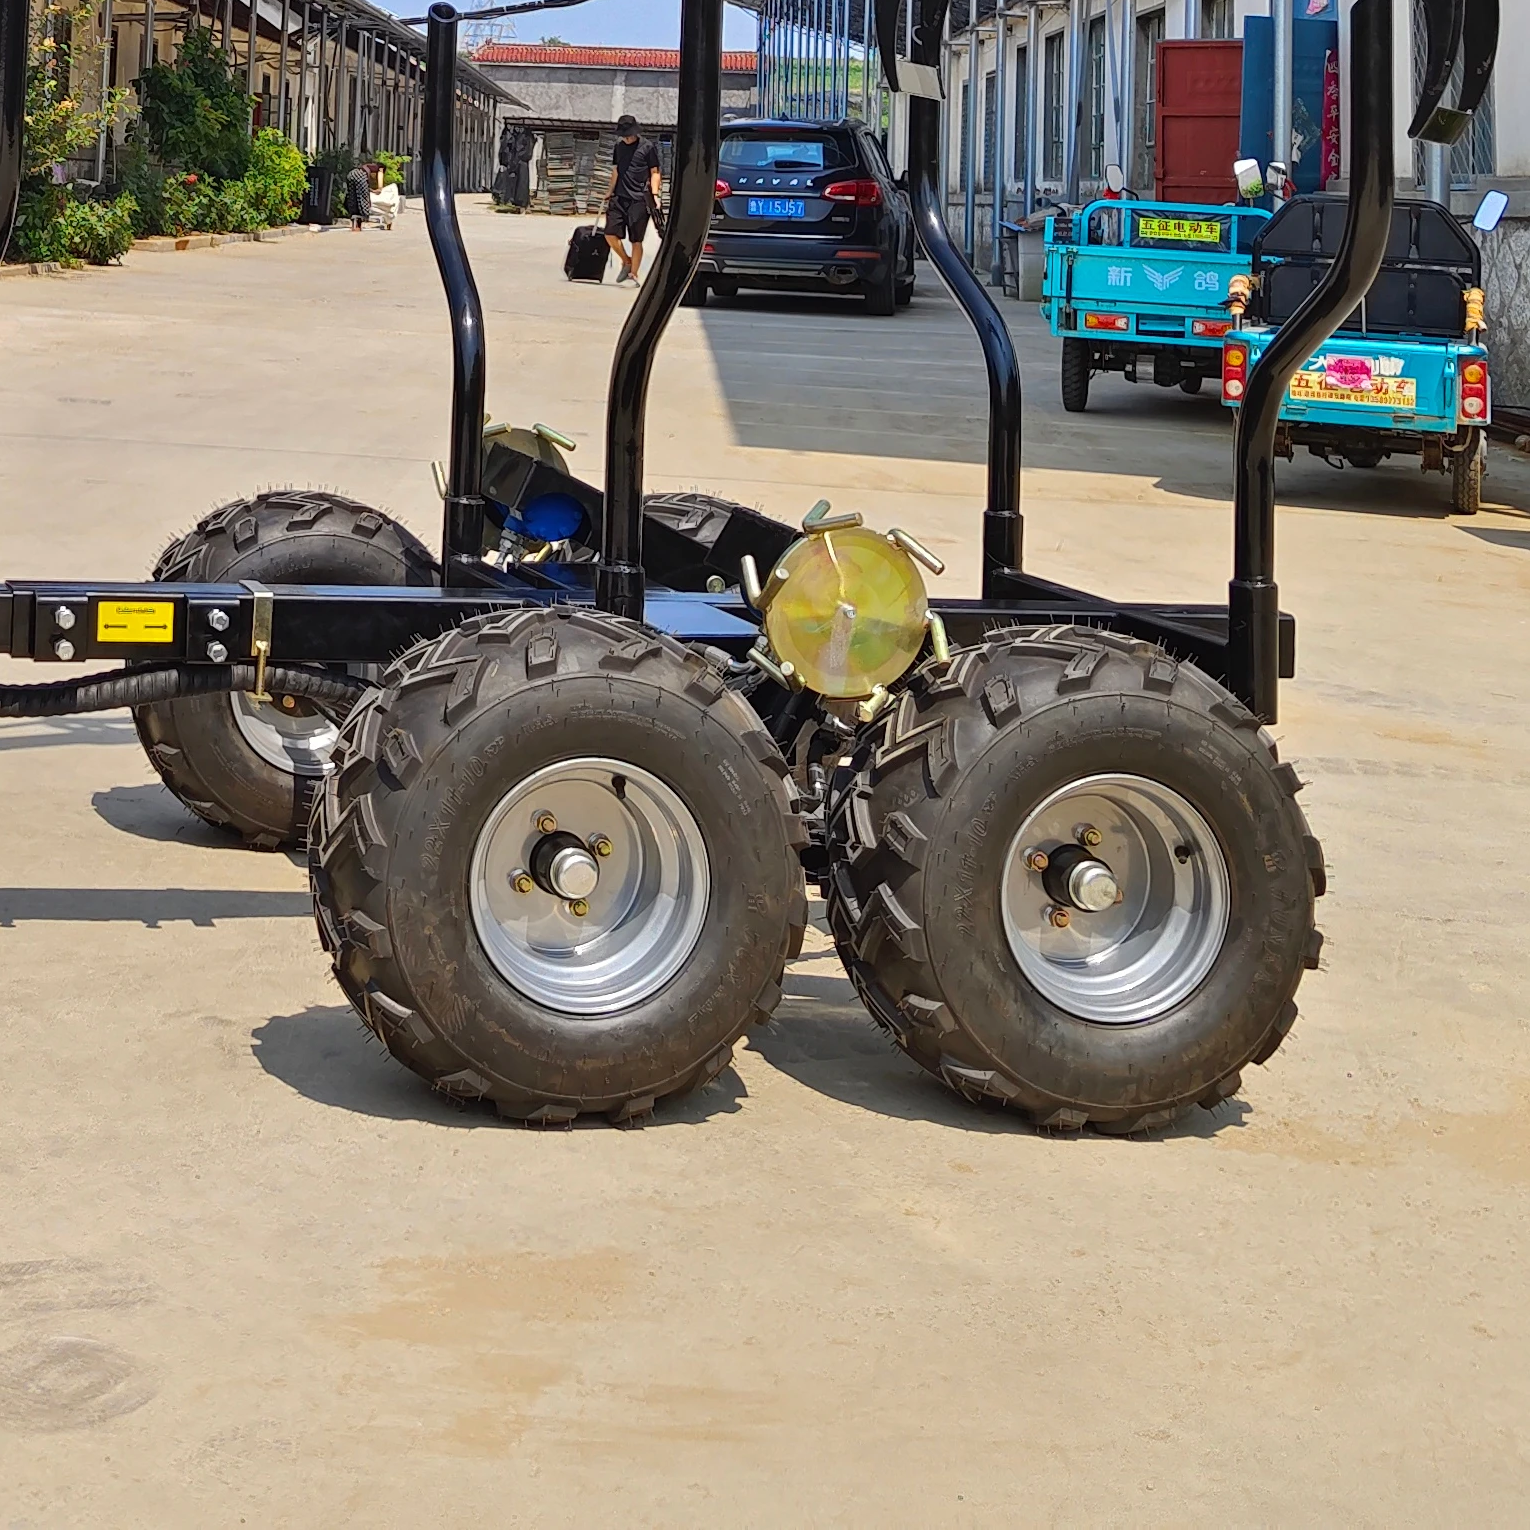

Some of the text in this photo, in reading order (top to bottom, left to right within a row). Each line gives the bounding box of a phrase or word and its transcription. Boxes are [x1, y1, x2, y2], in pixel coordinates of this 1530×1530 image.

[738, 177, 813, 187] HAVAL
[1141, 219, 1219, 235] 五征电动车
[1108, 266, 1132, 286] 新
